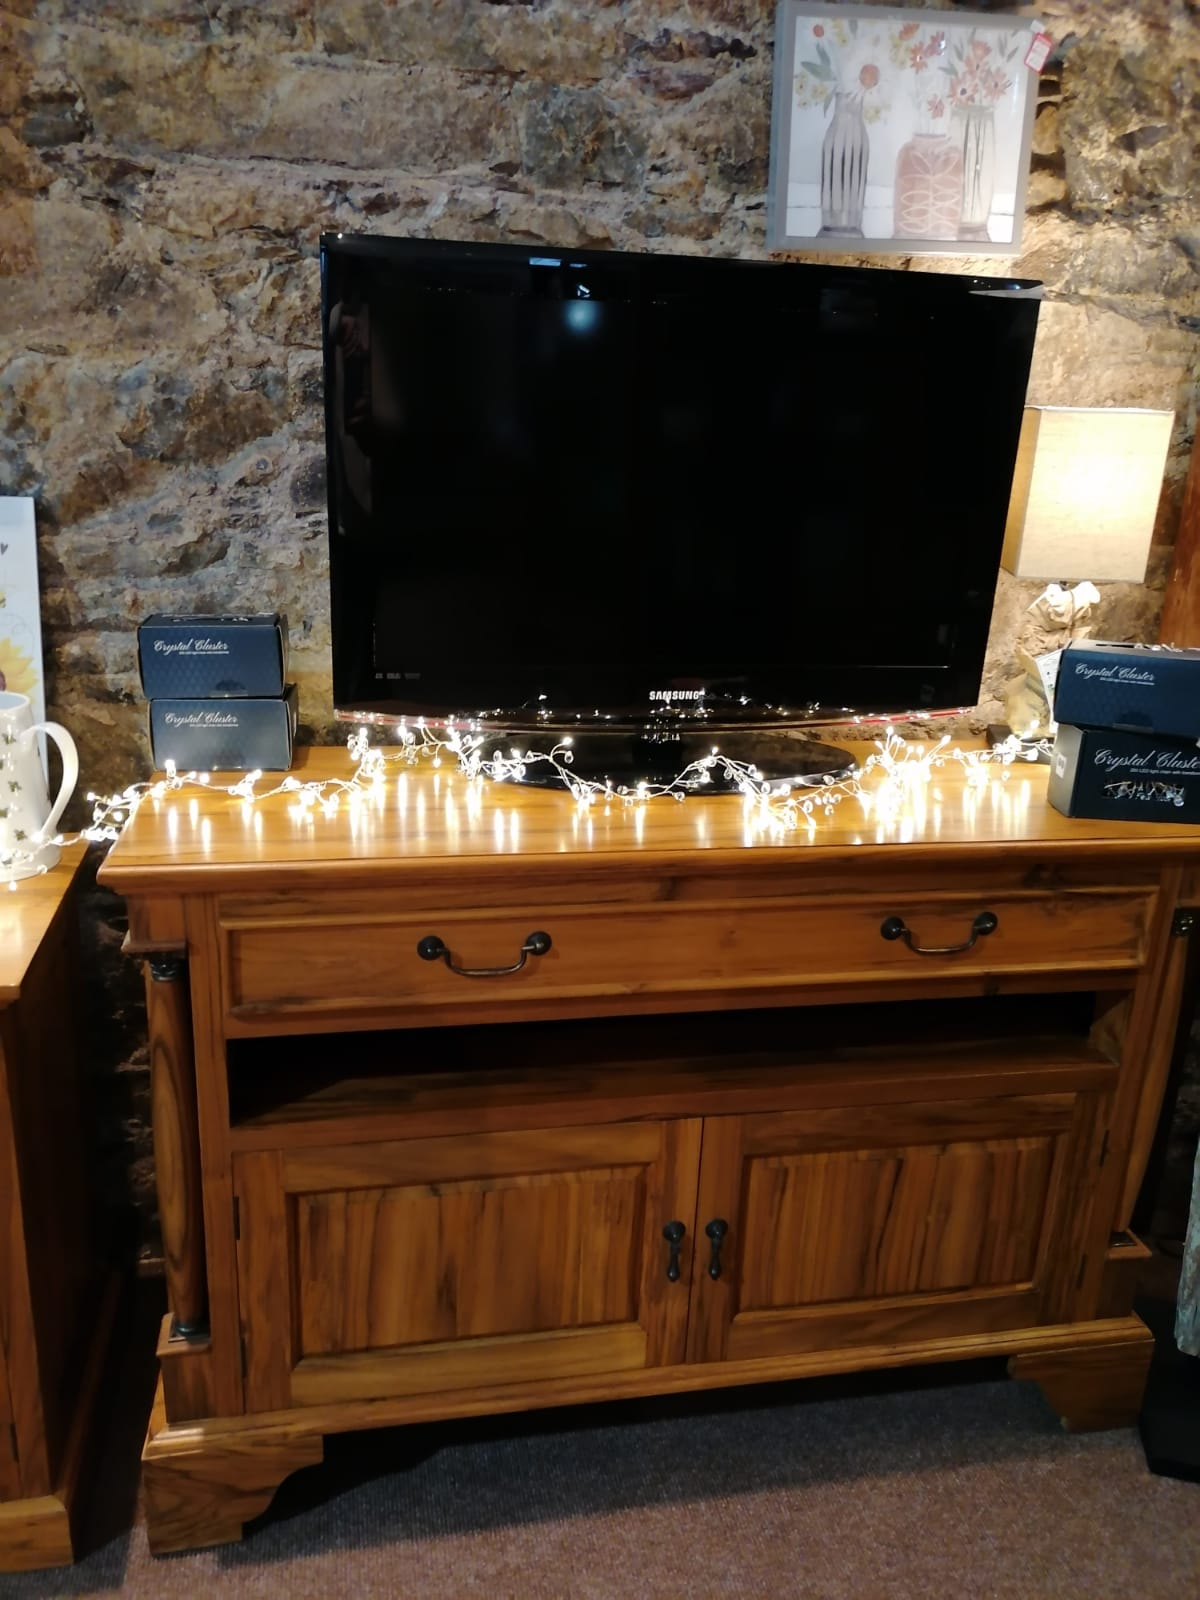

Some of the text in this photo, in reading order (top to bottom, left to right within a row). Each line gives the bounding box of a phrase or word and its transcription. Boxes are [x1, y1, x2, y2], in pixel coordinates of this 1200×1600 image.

[153, 638, 228, 656] Crystal Cluster
[1075, 662, 1117, 679] Crystal
[1118, 666, 1154, 681] Cluster
[649, 690, 700, 701] SAMSUNG
[164, 711, 238, 728] Crystal Cluster
[1094, 748, 1156, 772] Crystal
[1156, 751, 1200, 769] Cluste
